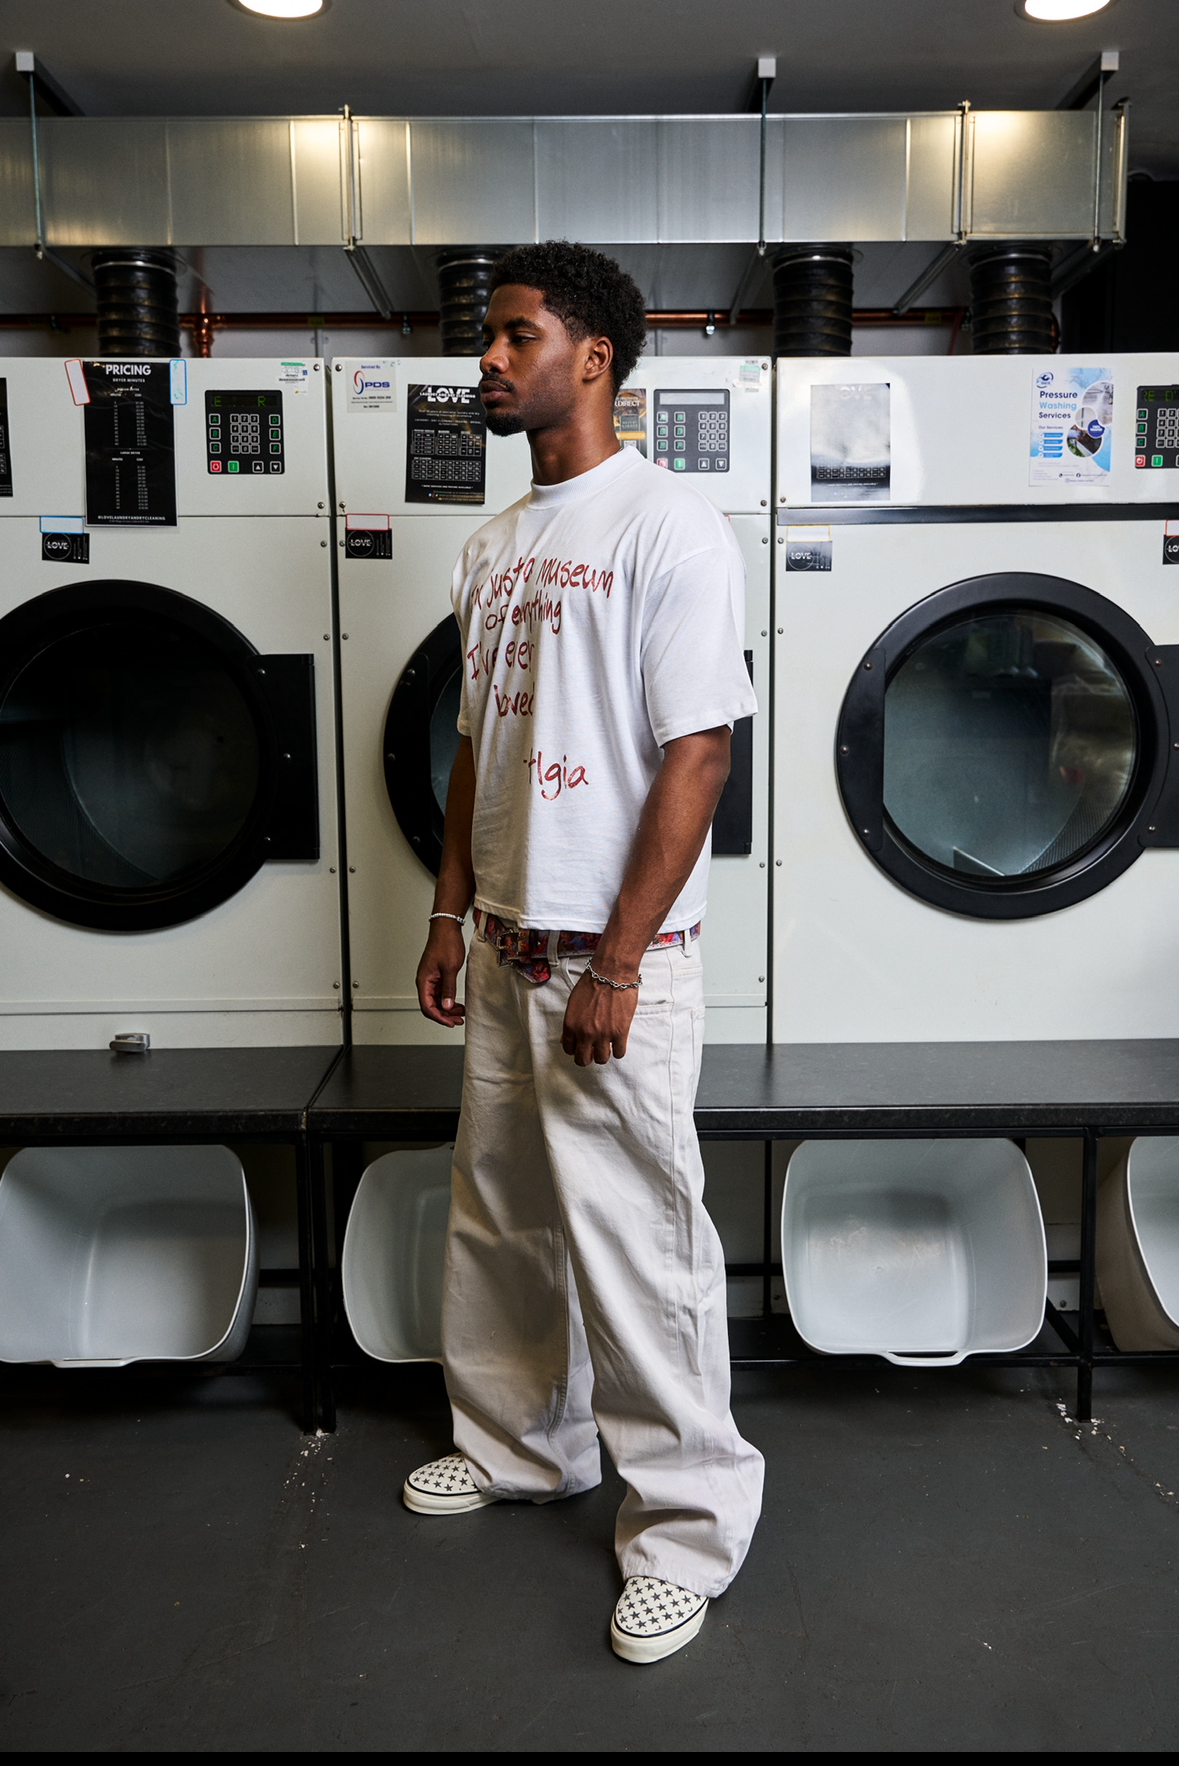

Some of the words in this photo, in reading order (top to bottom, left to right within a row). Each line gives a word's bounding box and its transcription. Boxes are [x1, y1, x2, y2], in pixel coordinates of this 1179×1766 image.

[105, 364, 152, 375] PRICING
[427, 387, 470, 404] LOVE
[1039, 391, 1078, 399] Pressure
[1039, 402, 1077, 411] Washing
[47, 541, 68, 550] LOVE
[351, 539, 371, 547] LOVE
[791, 552, 811, 560] LOVE
[485, 604, 509, 630] of
